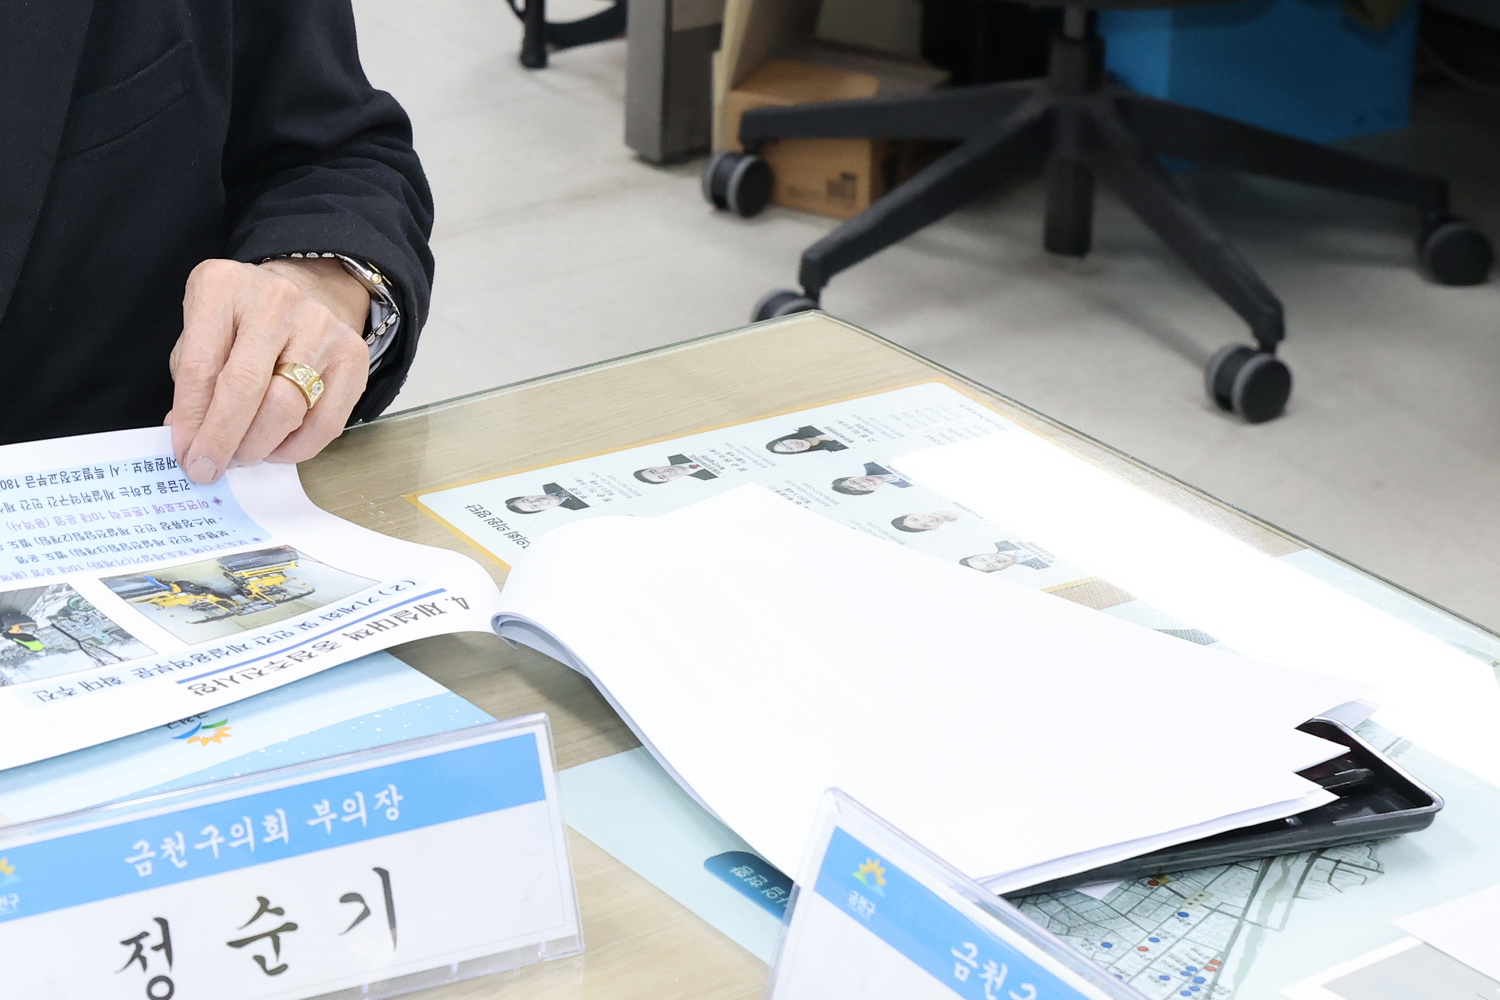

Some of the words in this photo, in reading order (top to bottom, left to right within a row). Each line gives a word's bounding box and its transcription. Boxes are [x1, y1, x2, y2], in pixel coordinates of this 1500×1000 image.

[109, 464, 120, 477] 시
[131, 455, 177, 474] 재원확보
[24, 466, 105, 489] 특별조정교부금
[119, 484, 152, 499] 요하는
[156, 478, 190, 495] 긴급을
[19, 498, 43, 511] 민간
[47, 488, 114, 509] 제설취약구간
[152, 497, 209, 516] 이면도로에
[465, 504, 492, 519] 명단
[6, 516, 50, 532] (용역사)
[53, 513, 77, 526] 운영
[79, 510, 105, 523] 10대
[160, 515, 216, 532] 버스정류장
[34, 524, 129, 548] 제설전담팀(2개팀)
[132, 523, 156, 535] 민간
[195, 529, 229, 541] 보행로
[6, 538, 31, 550] 별도
[69, 536, 166, 559] 제설전담팀(3개팀)
[15, 553, 39, 565] 운영
[42, 550, 67, 562] 별도
[30, 567, 55, 578] 운영
[58, 563, 82, 574] 10대
[252, 631, 295, 646] 민간
[130, 644, 252, 679] 제설용역부문
[187, 640, 342, 696] 중점추진사항
[78, 677, 124, 692] 확대
[32, 687, 79, 702] 추진
[124, 808, 290, 877] 금천구의회
[306, 784, 404, 834] 부의장
[730, 865, 769, 888] 현황
[848, 889, 876, 916] 금천구
